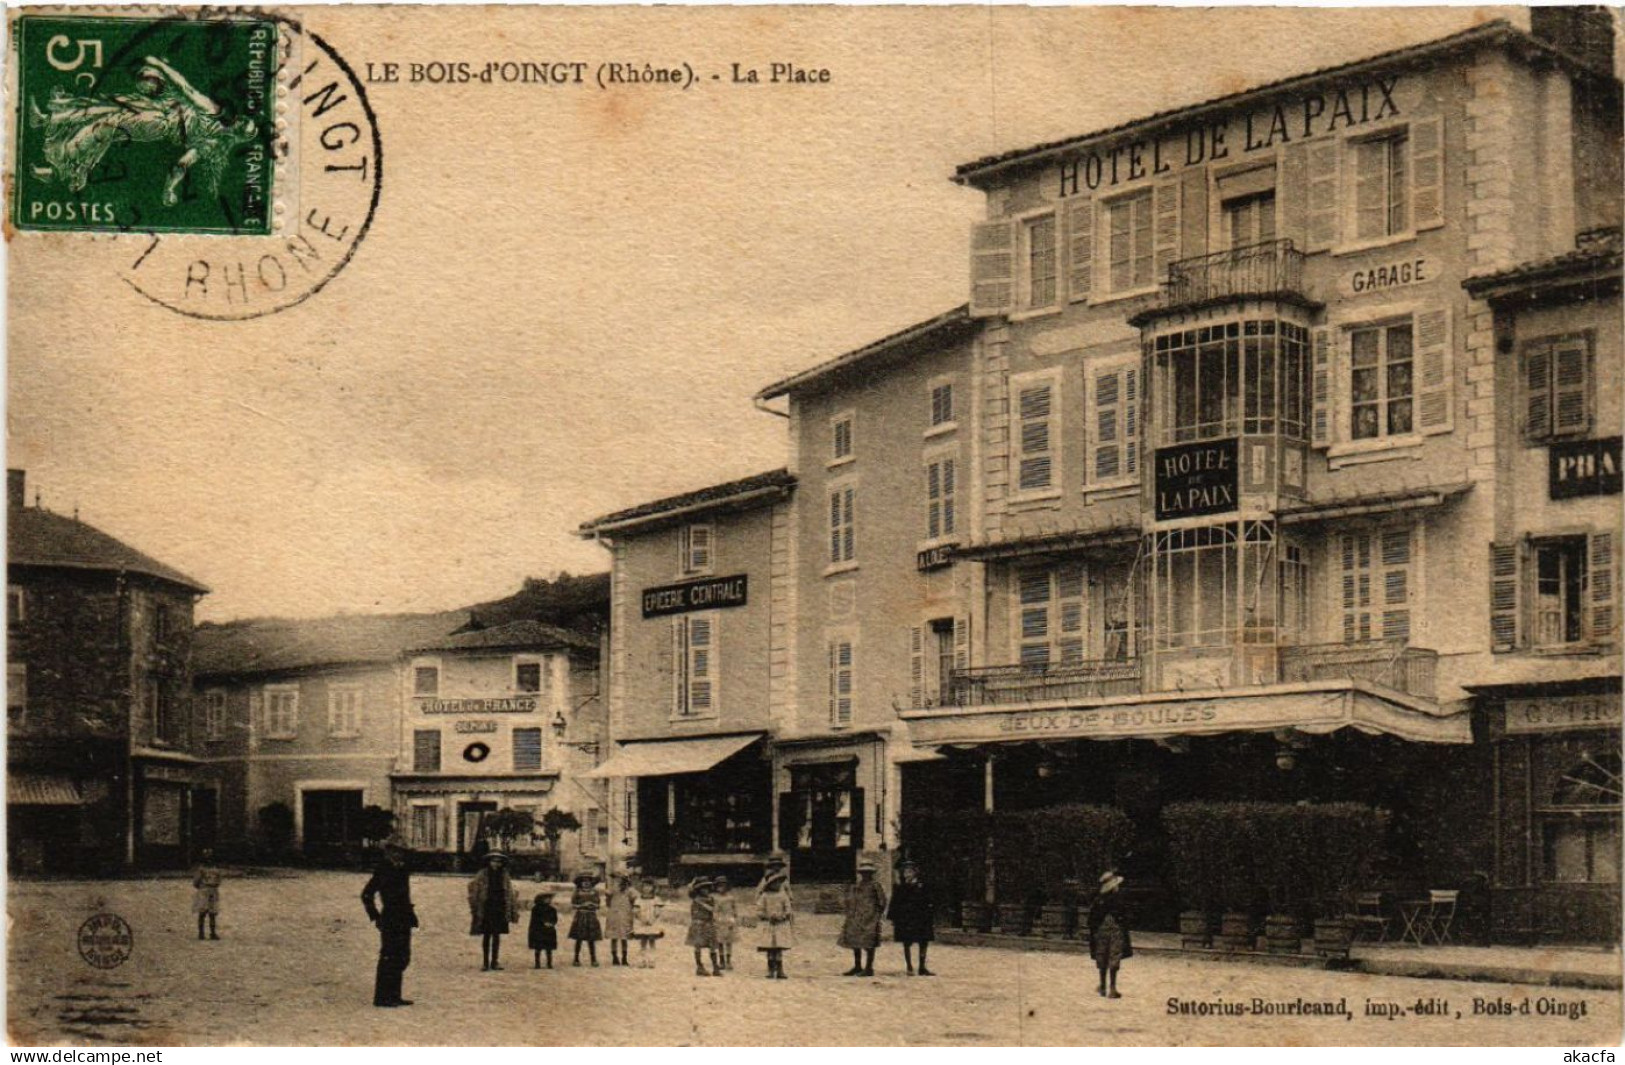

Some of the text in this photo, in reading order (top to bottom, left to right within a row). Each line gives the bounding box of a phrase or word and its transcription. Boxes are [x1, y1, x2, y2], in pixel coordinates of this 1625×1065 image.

[1059, 75, 1401, 197] HOTEL DE LA PAIX
[30, 202, 116, 221] POSTES
[185, 207, 348, 304] RHONE
[1352, 260, 1425, 292] GARAGE
[1164, 449, 1231, 478] HOTEL
[1161, 484, 1233, 512] LA PAIX
[425, 700, 466, 713] HOTEL
[484, 698, 534, 712] FRANCE
